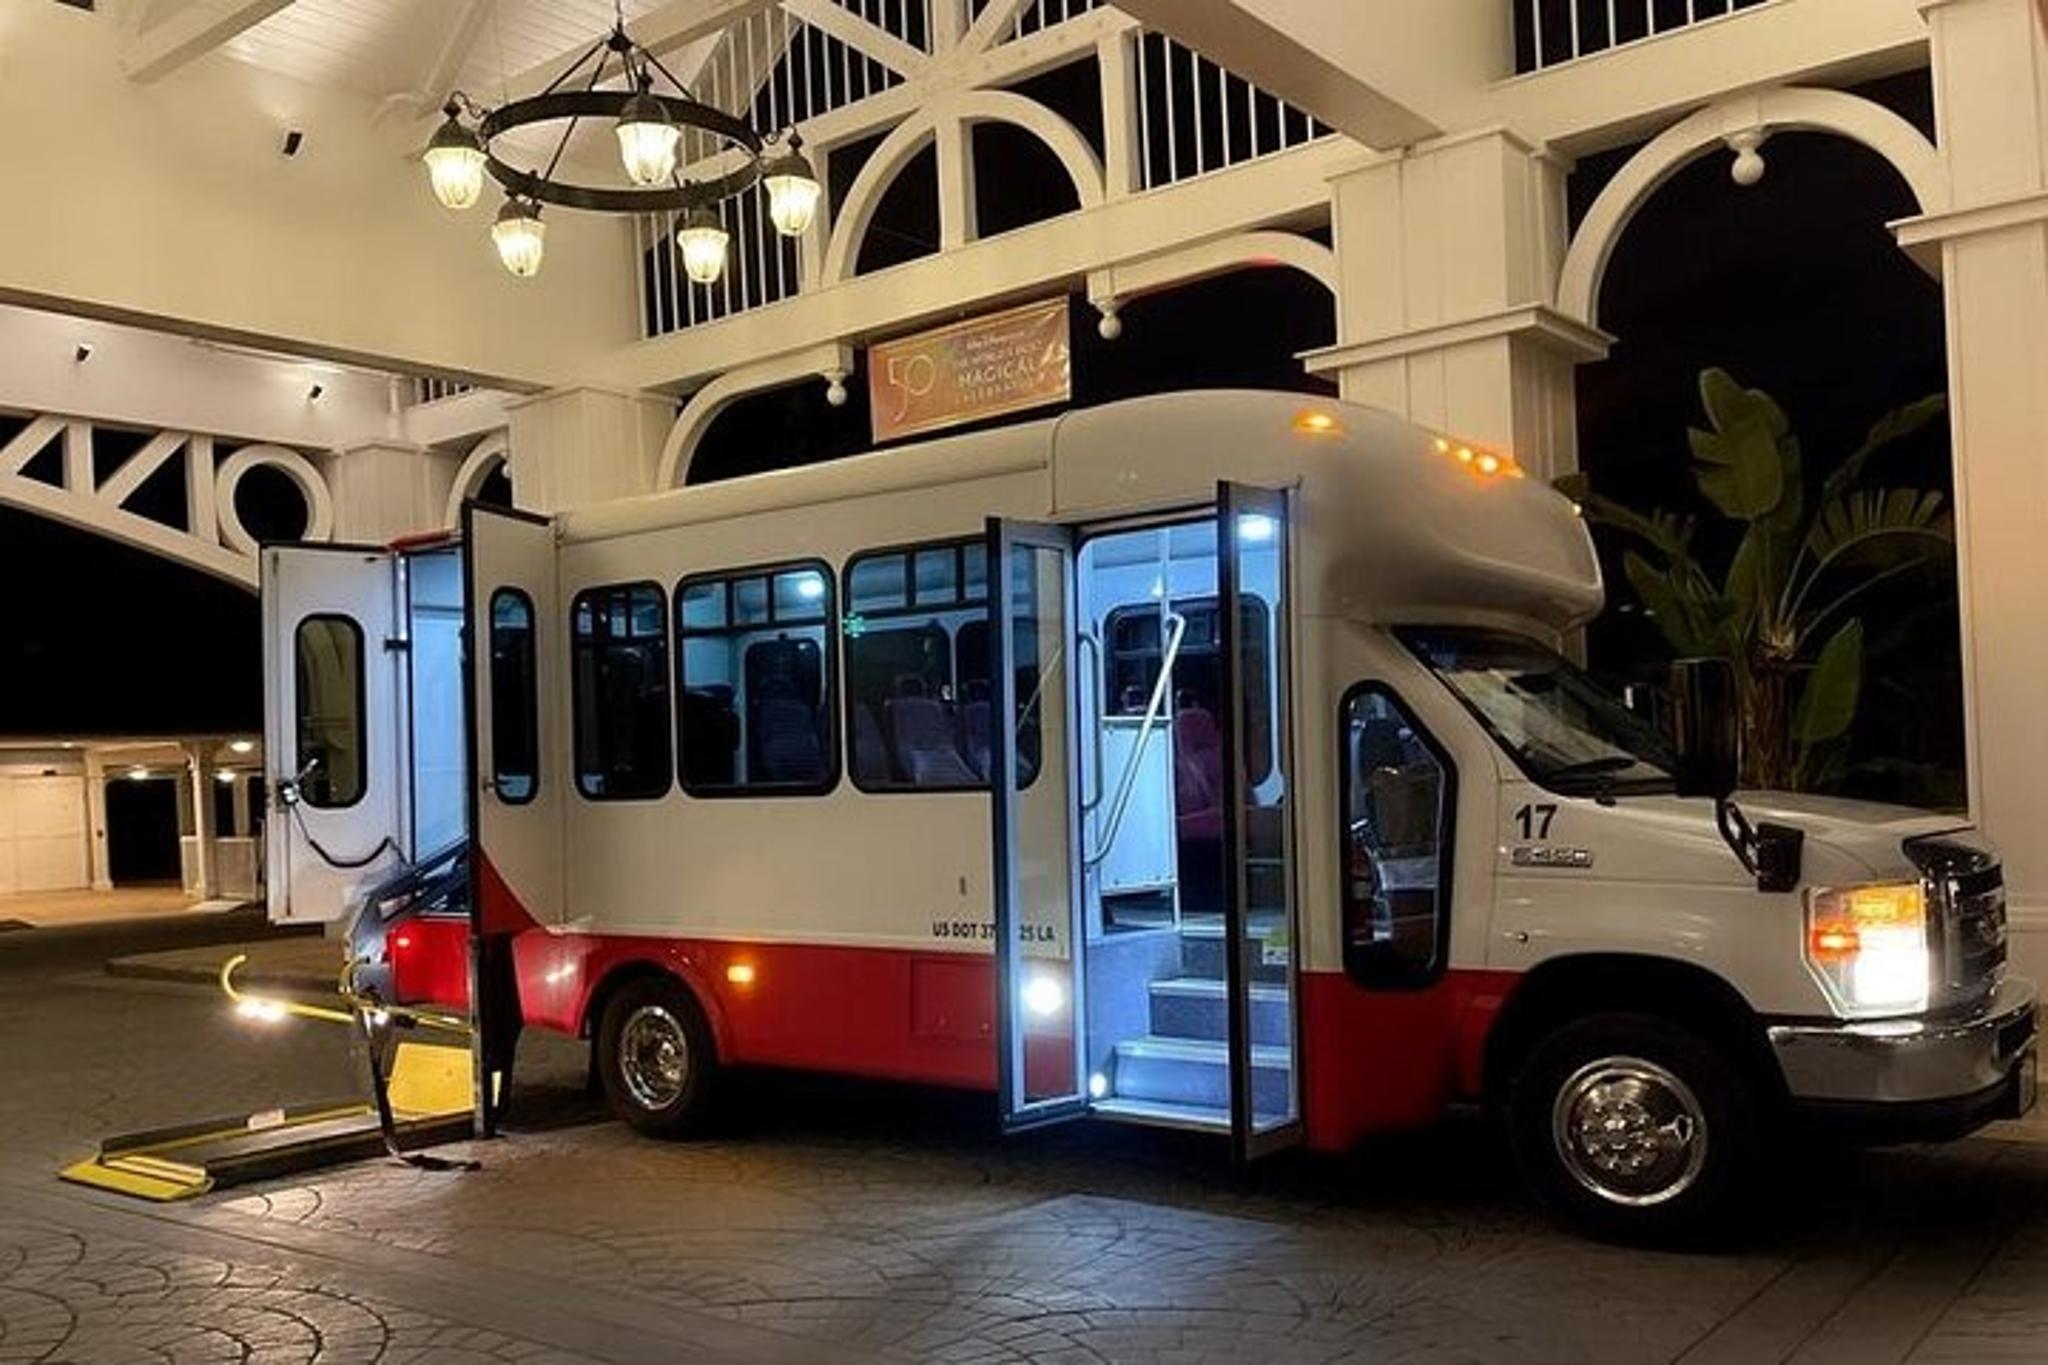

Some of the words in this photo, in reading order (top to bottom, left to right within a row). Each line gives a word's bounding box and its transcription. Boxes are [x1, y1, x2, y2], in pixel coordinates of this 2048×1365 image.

[888, 354, 936, 422] 50
[957, 356, 1036, 387] MAGICAL
[1515, 804, 1557, 839] 17
[933, 921, 949, 938] US
[952, 921, 977, 938] DOT
[1037, 924, 1056, 942] LA
